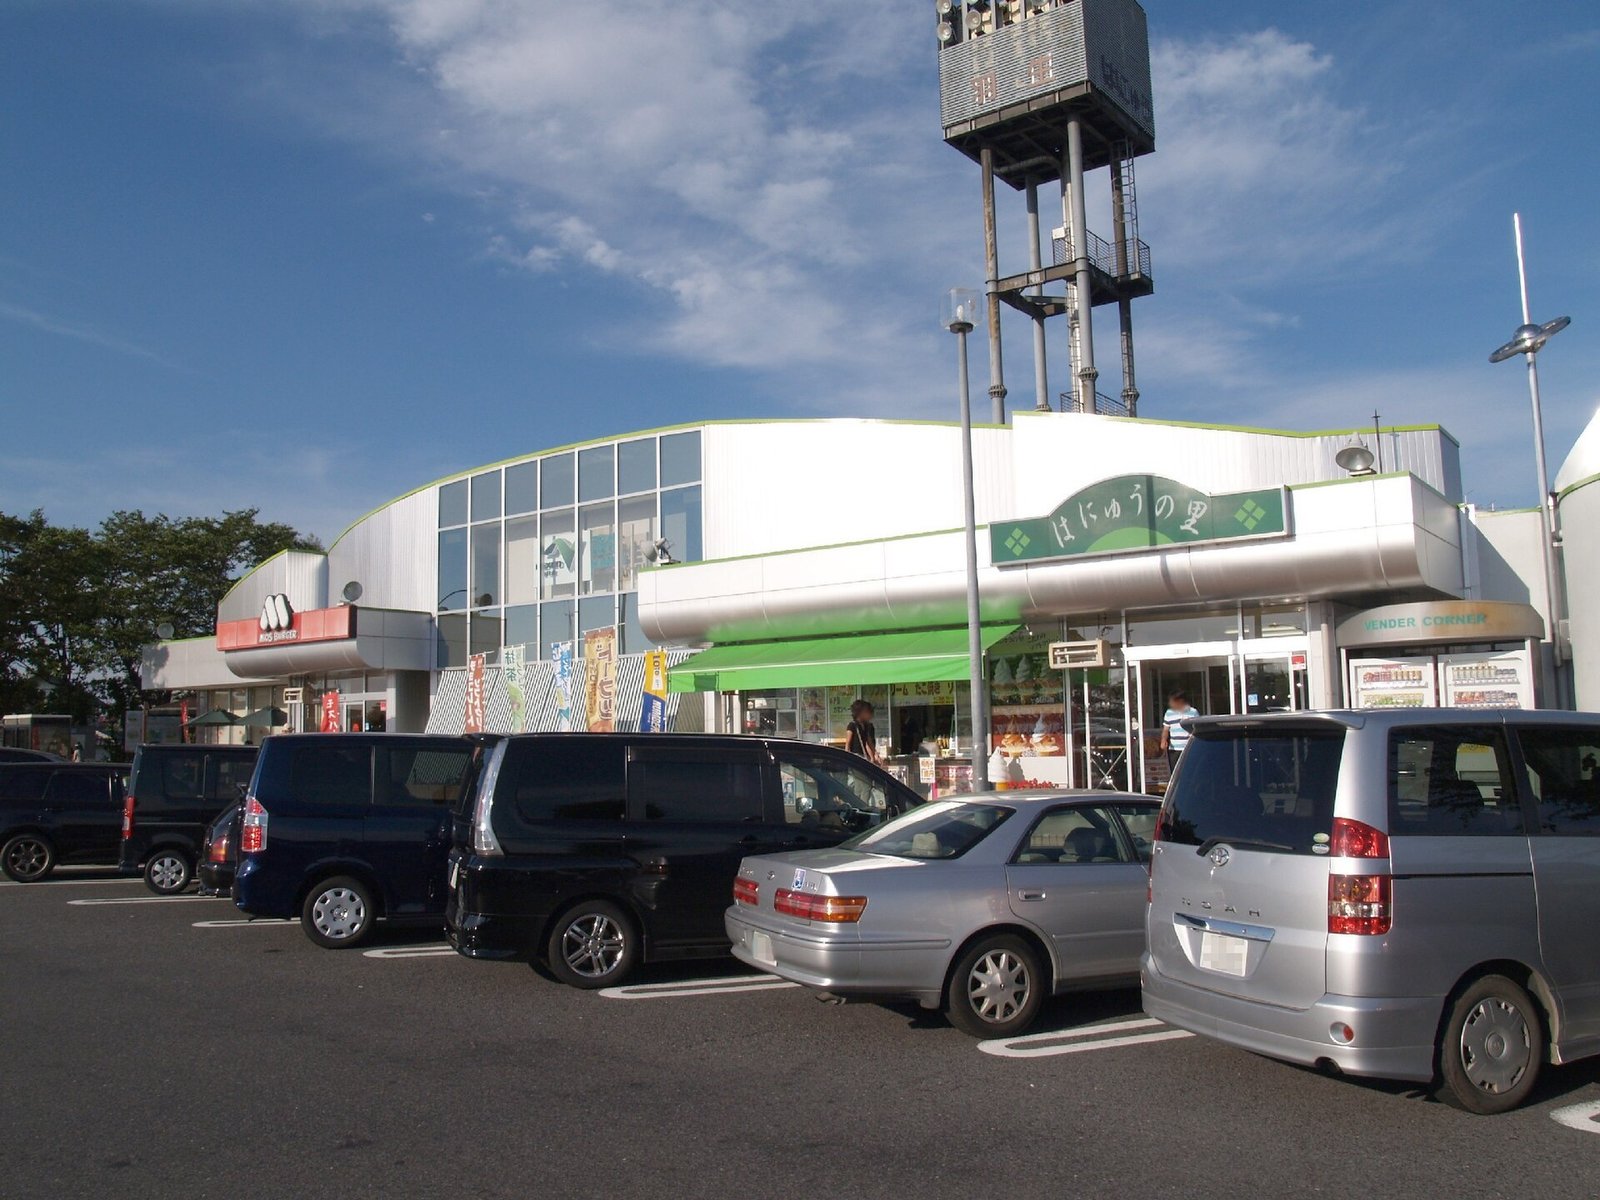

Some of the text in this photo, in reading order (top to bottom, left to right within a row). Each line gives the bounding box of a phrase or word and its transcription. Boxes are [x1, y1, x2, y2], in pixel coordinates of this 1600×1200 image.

[1052, 484, 1208, 549] はにゅうの里
[1364, 612, 1487, 632] VENDER CORNER
